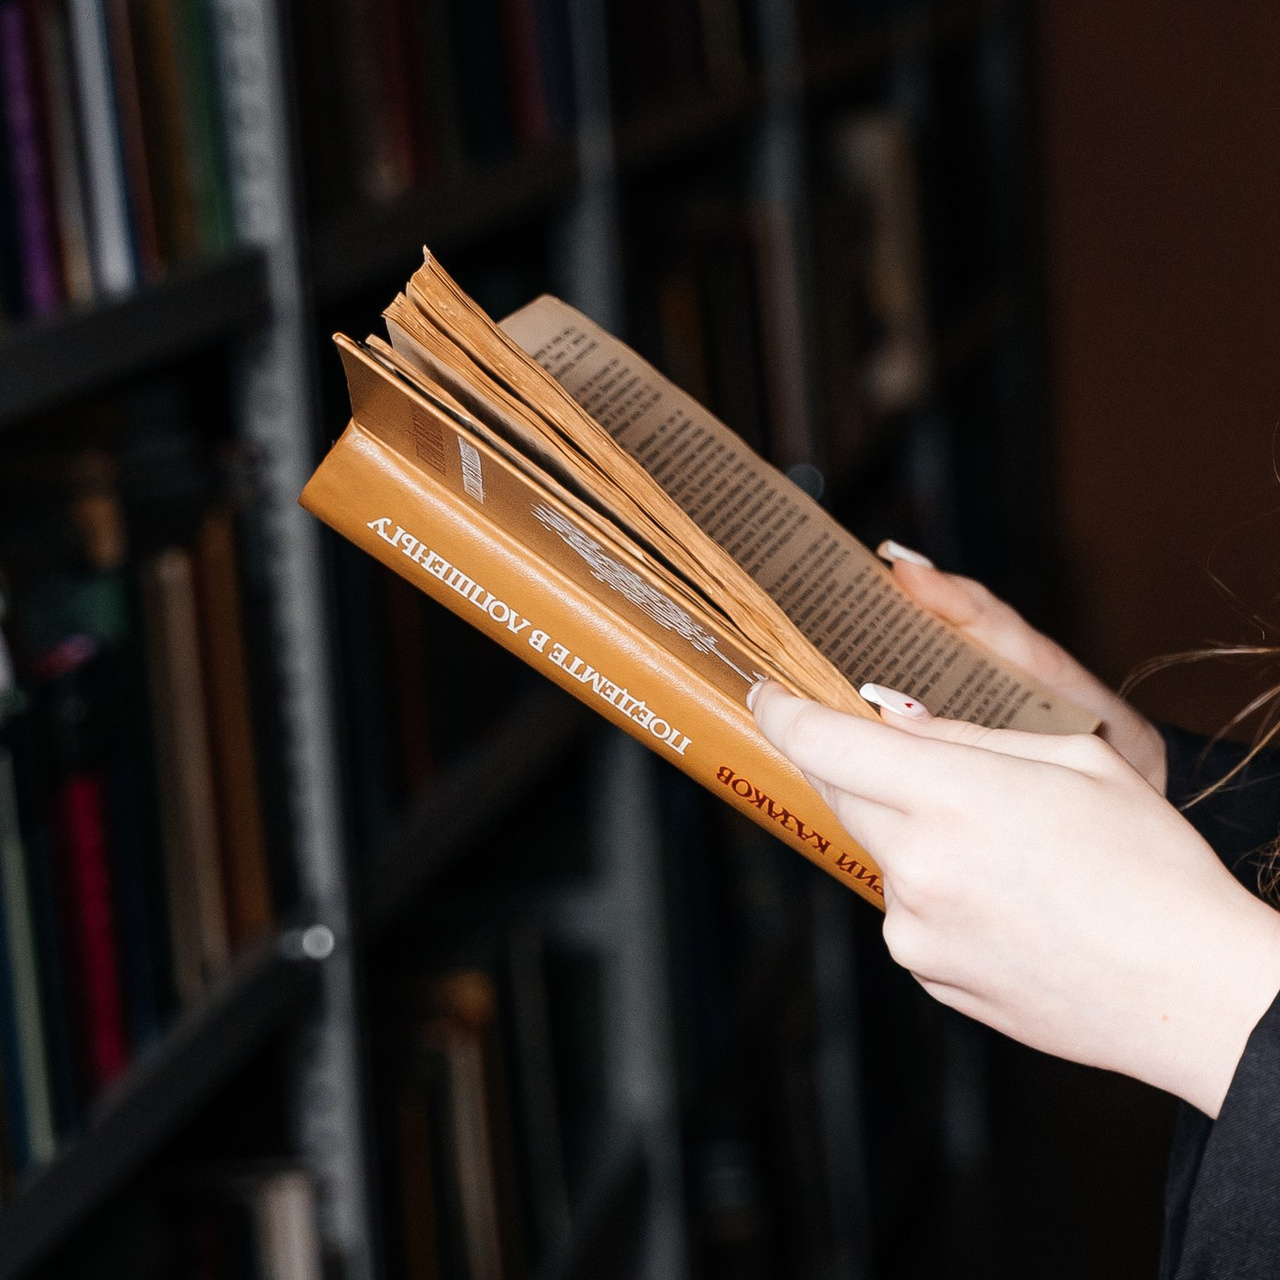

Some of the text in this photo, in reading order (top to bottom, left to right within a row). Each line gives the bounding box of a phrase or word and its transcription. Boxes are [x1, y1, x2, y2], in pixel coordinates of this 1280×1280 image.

[366, 517, 693, 756] ПОЕДЕМТЕ В ЛОПШЕНЬГУ
[716, 765, 885, 898] РИЙ КАЗАКОВ
